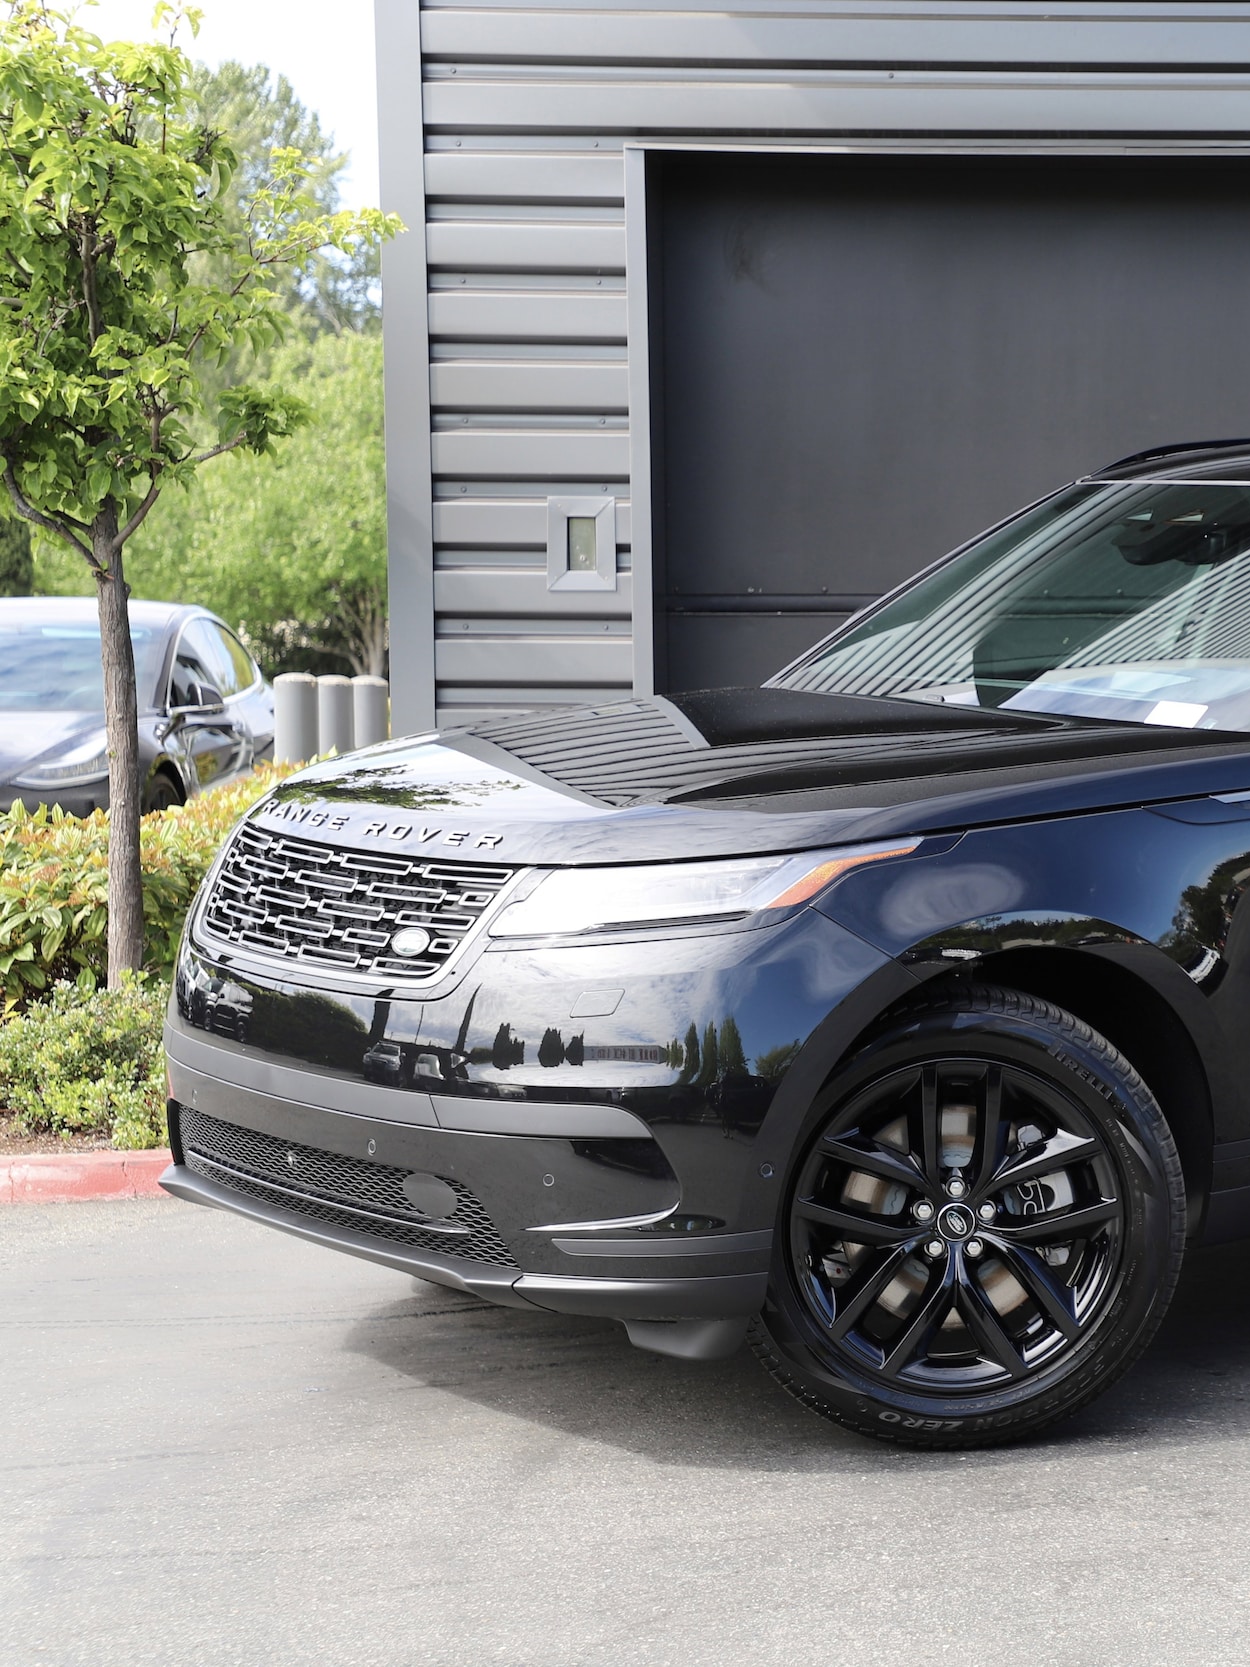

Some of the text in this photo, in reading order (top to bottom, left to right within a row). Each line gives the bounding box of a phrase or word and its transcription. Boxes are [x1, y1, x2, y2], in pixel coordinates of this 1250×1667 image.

[262, 798, 504, 850] RANGE ROVER
[877, 1409, 964, 1432] ZERO
